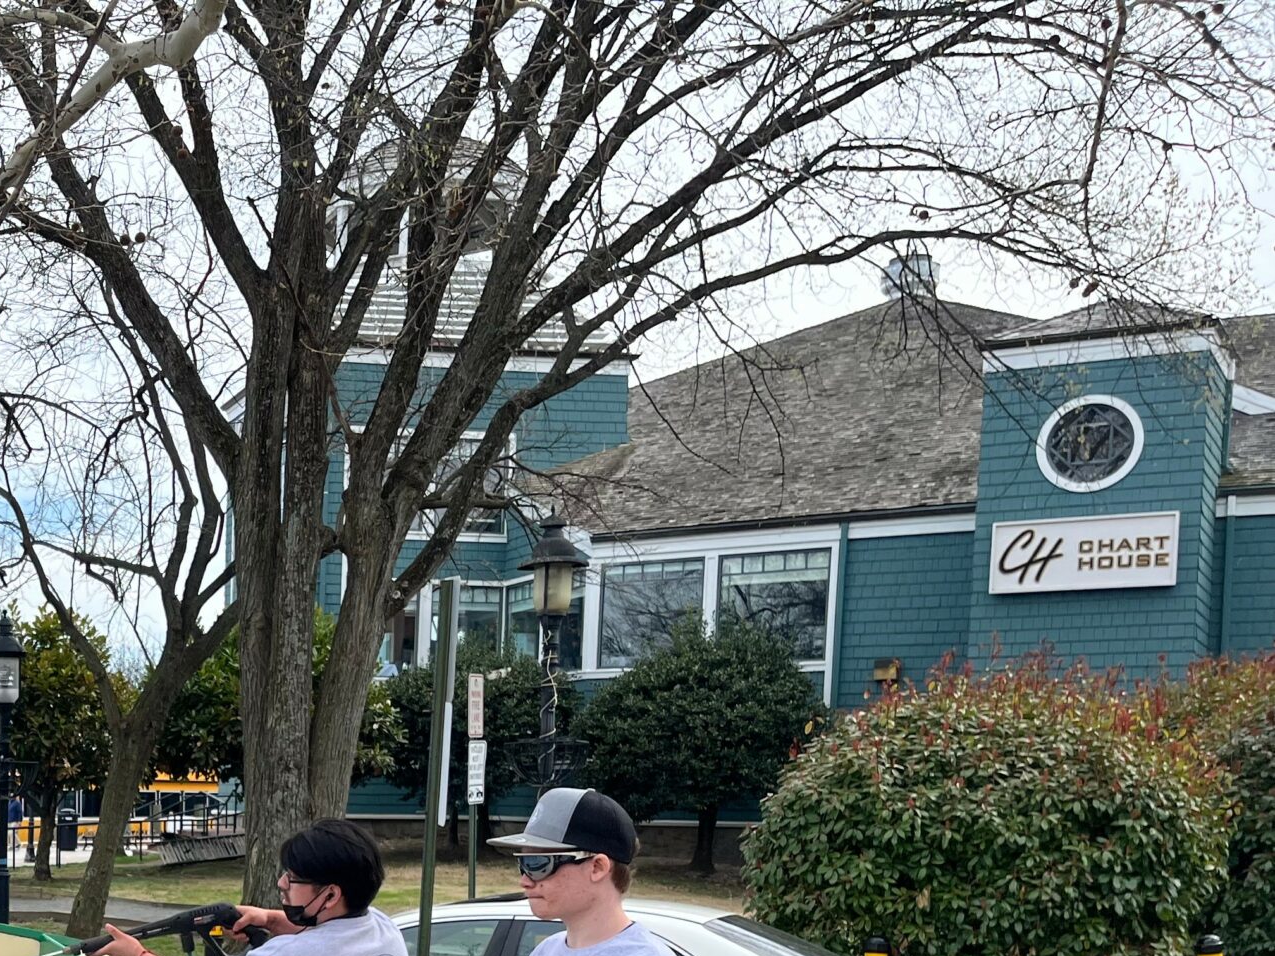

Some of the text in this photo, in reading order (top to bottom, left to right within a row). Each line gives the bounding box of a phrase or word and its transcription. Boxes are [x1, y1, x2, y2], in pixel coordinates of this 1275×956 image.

[1079, 536, 1171, 554] CHART
[999, 529, 1064, 585] CH
[1077, 553, 1171, 571] HOUSE
